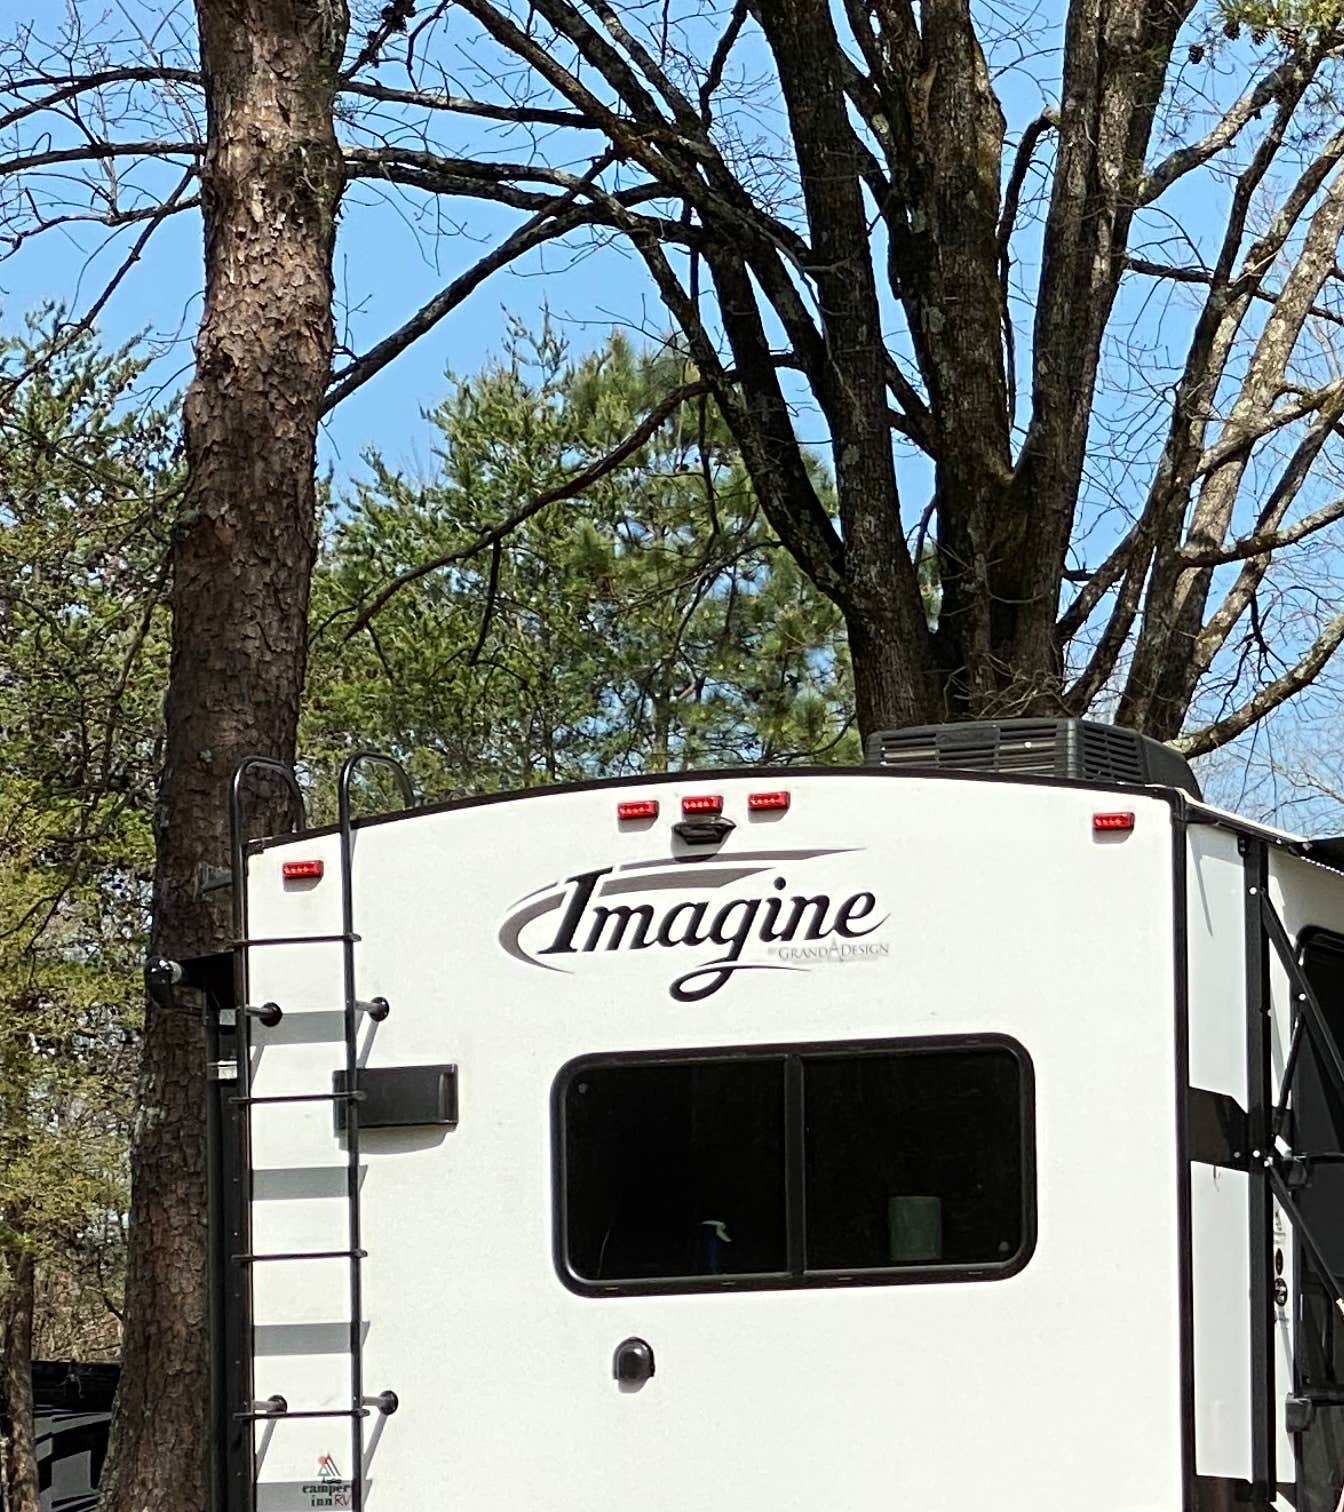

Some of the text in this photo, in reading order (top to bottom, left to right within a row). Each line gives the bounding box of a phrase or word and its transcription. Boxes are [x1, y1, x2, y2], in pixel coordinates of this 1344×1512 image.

[537, 866, 891, 1002] Imagine
[778, 945, 828, 961] GRAND
[840, 943, 890, 957] DESIGN
[302, 1484, 351, 1496] camper
[311, 1494, 352, 1507] inn RV
